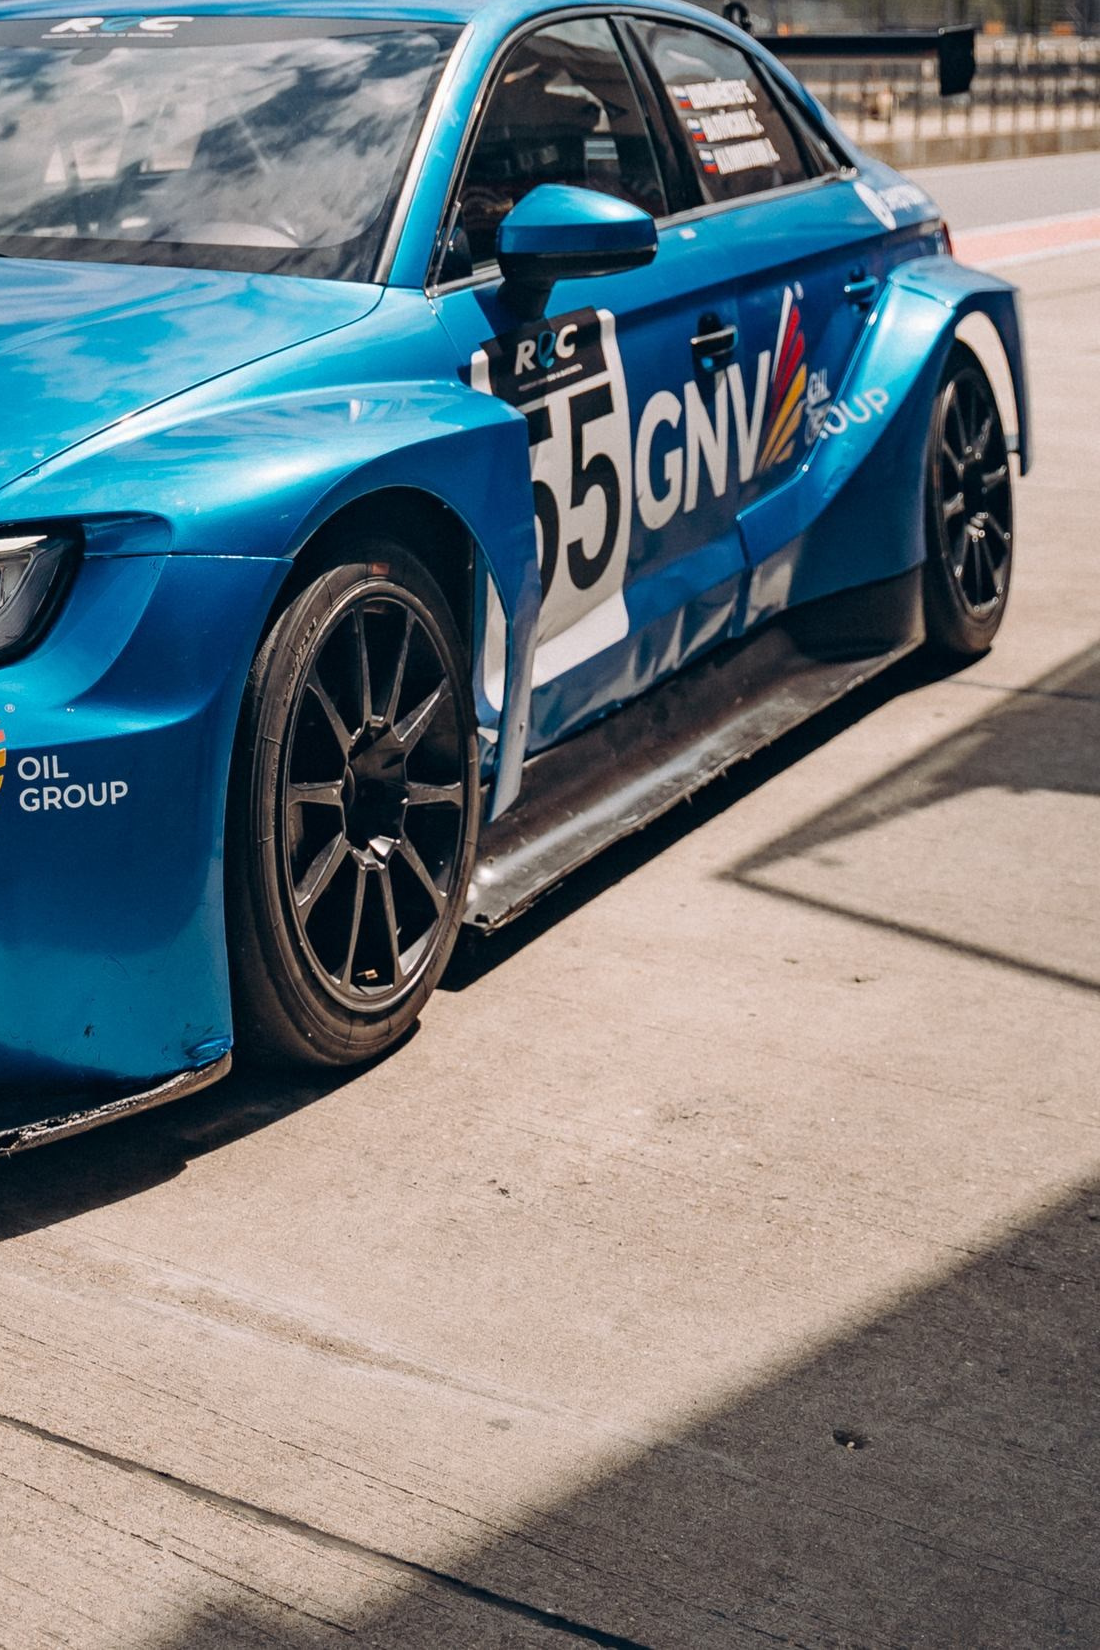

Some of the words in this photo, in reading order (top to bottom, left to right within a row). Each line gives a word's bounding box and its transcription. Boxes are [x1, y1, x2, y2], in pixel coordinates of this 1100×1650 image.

[635, 350, 770, 531] GNV
[17, 756, 69, 781] OIL
[18, 781, 129, 812] GROUP
